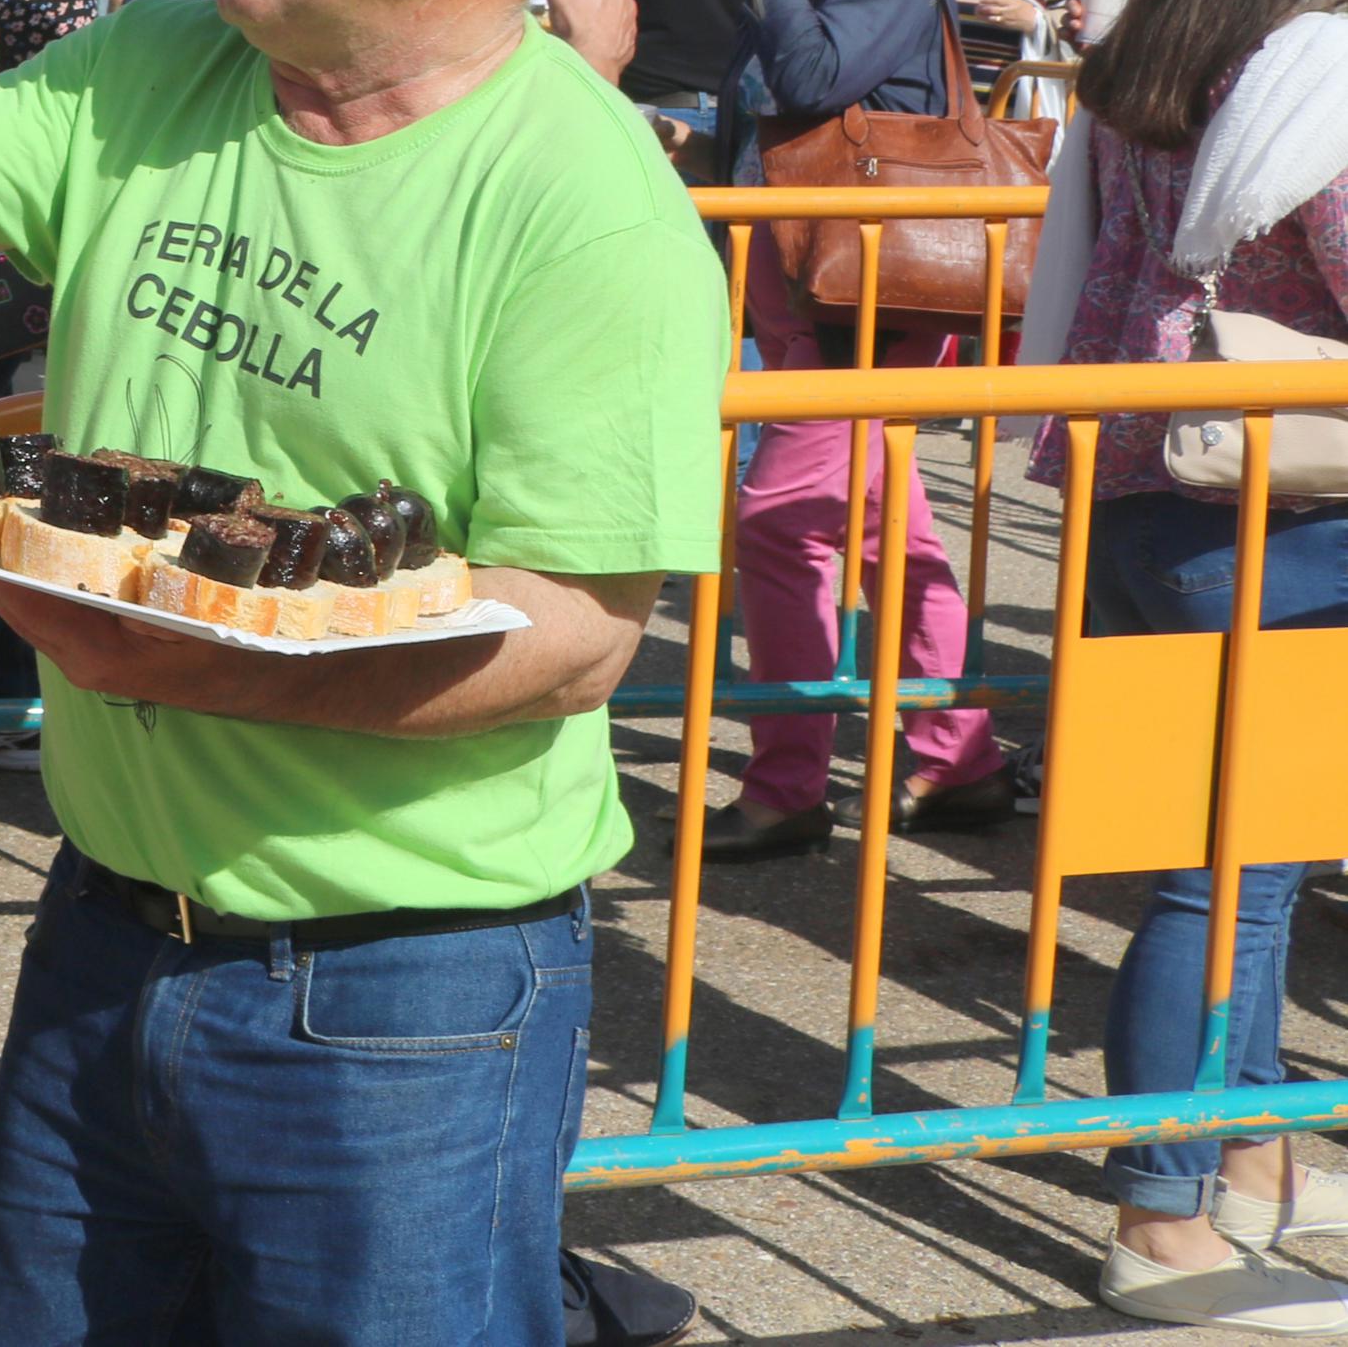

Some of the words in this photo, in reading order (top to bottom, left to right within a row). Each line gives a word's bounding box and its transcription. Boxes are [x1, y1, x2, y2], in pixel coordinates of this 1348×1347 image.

[126, 272, 323, 400] CEBOLLA
[133, 220, 251, 279] FERIA
[256, 246, 320, 309] DE
[313, 281, 380, 357] LA
